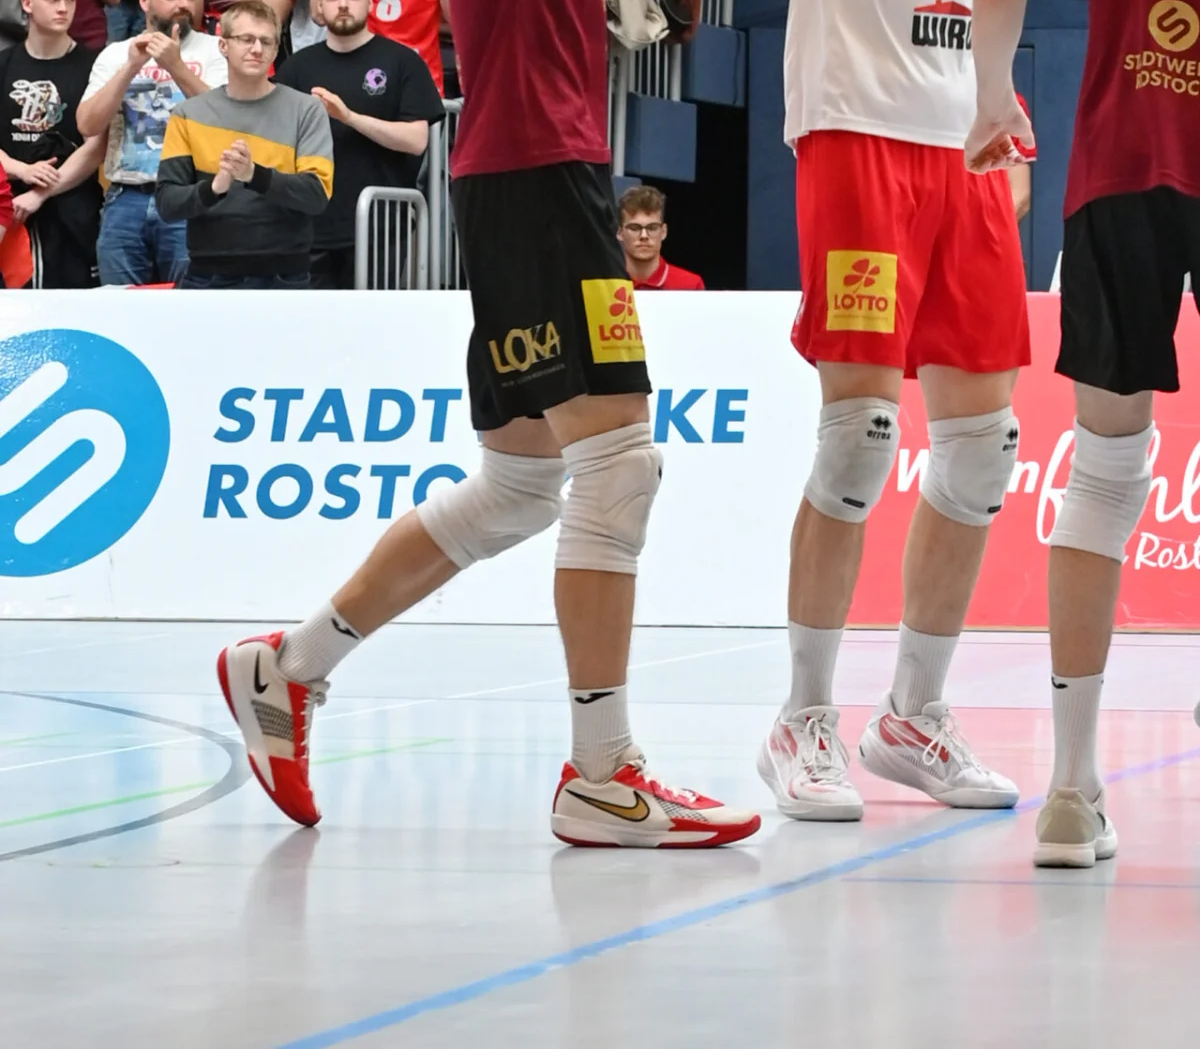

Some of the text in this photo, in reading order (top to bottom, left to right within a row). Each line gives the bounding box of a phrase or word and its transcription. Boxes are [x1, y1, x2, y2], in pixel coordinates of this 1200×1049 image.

[834, 294, 888, 312] LOTTO
[488, 321, 561, 374] LOKA
[213, 387, 749, 444] STADTKE
